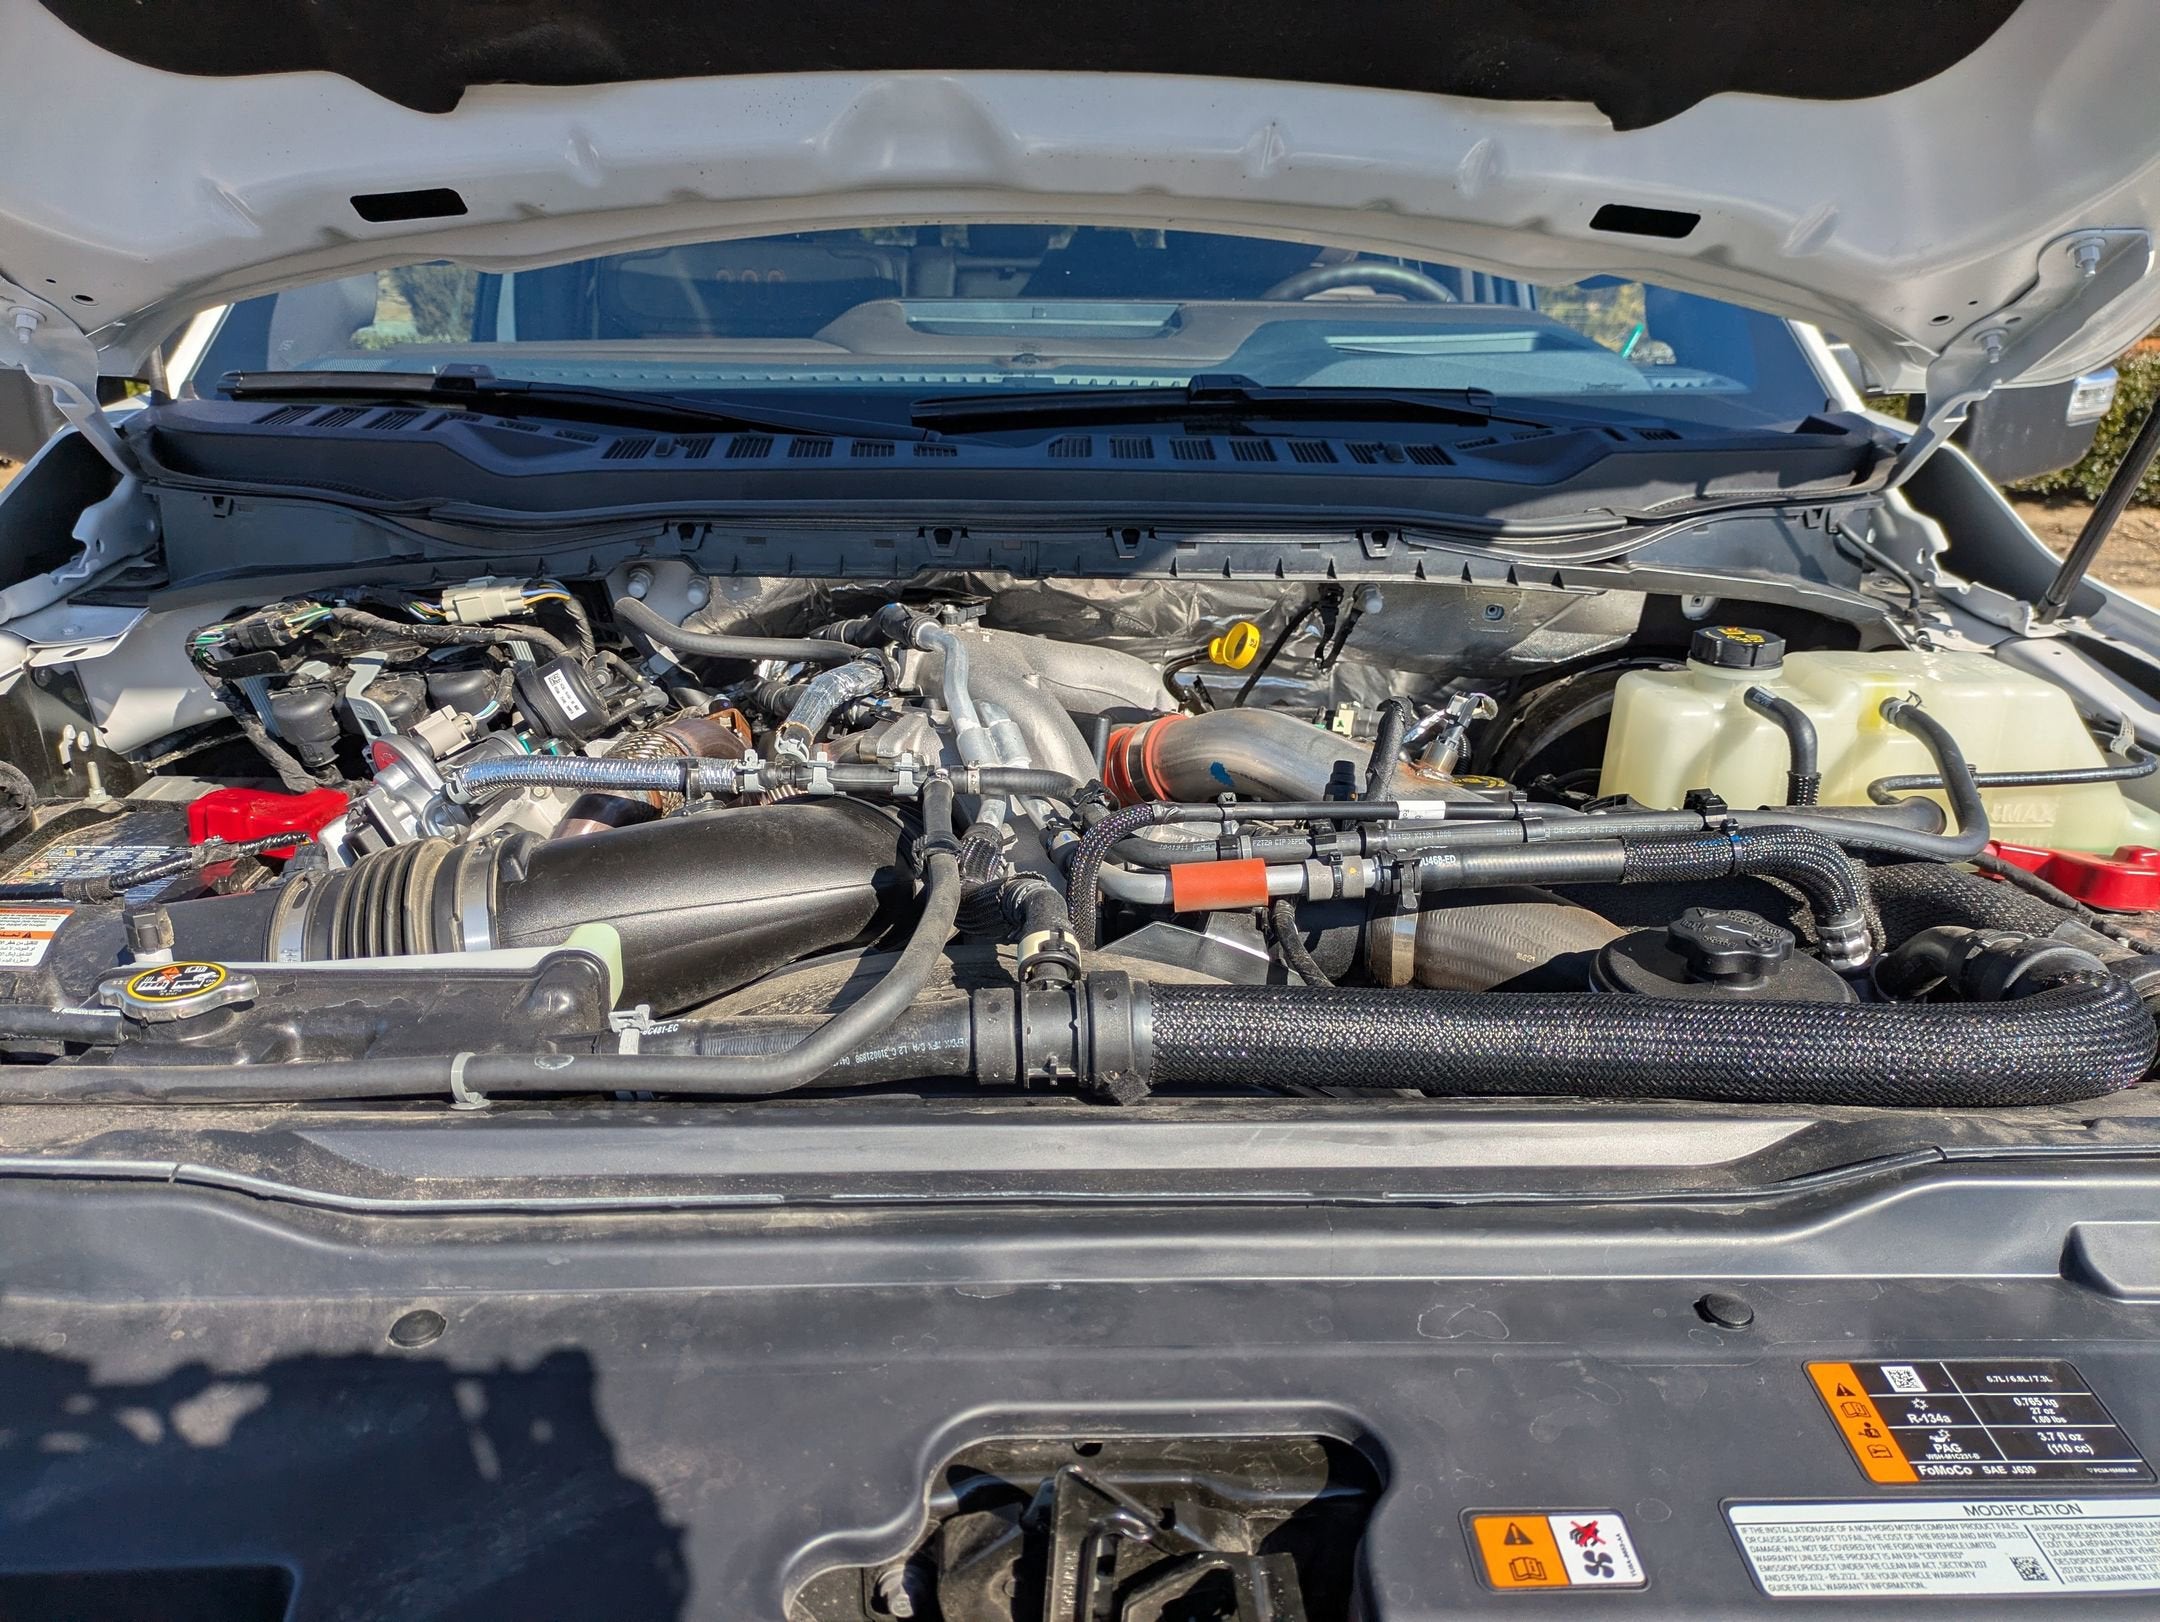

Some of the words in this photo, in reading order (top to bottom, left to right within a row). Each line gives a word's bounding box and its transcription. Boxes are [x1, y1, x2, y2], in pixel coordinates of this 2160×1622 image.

[2013, 1398, 2042, 1406] 0.765
[2043, 1398, 2059, 1408] kg
[1907, 1414, 1952, 1424] R-134a
[2037, 1432, 2055, 1441] 3.7
[2056, 1432, 2068, 1441] fl
[1934, 1444, 1962, 1453] PAG
[2047, 1444, 2073, 1455] (110
[2075, 1445, 2094, 1455] cc)
[1918, 1465, 1973, 1476] FoMoCo
[1982, 1465, 2007, 1474] SAE
[2012, 1466, 2037, 1474] J639
[1962, 1502, 2084, 1517] MODIFICATION
